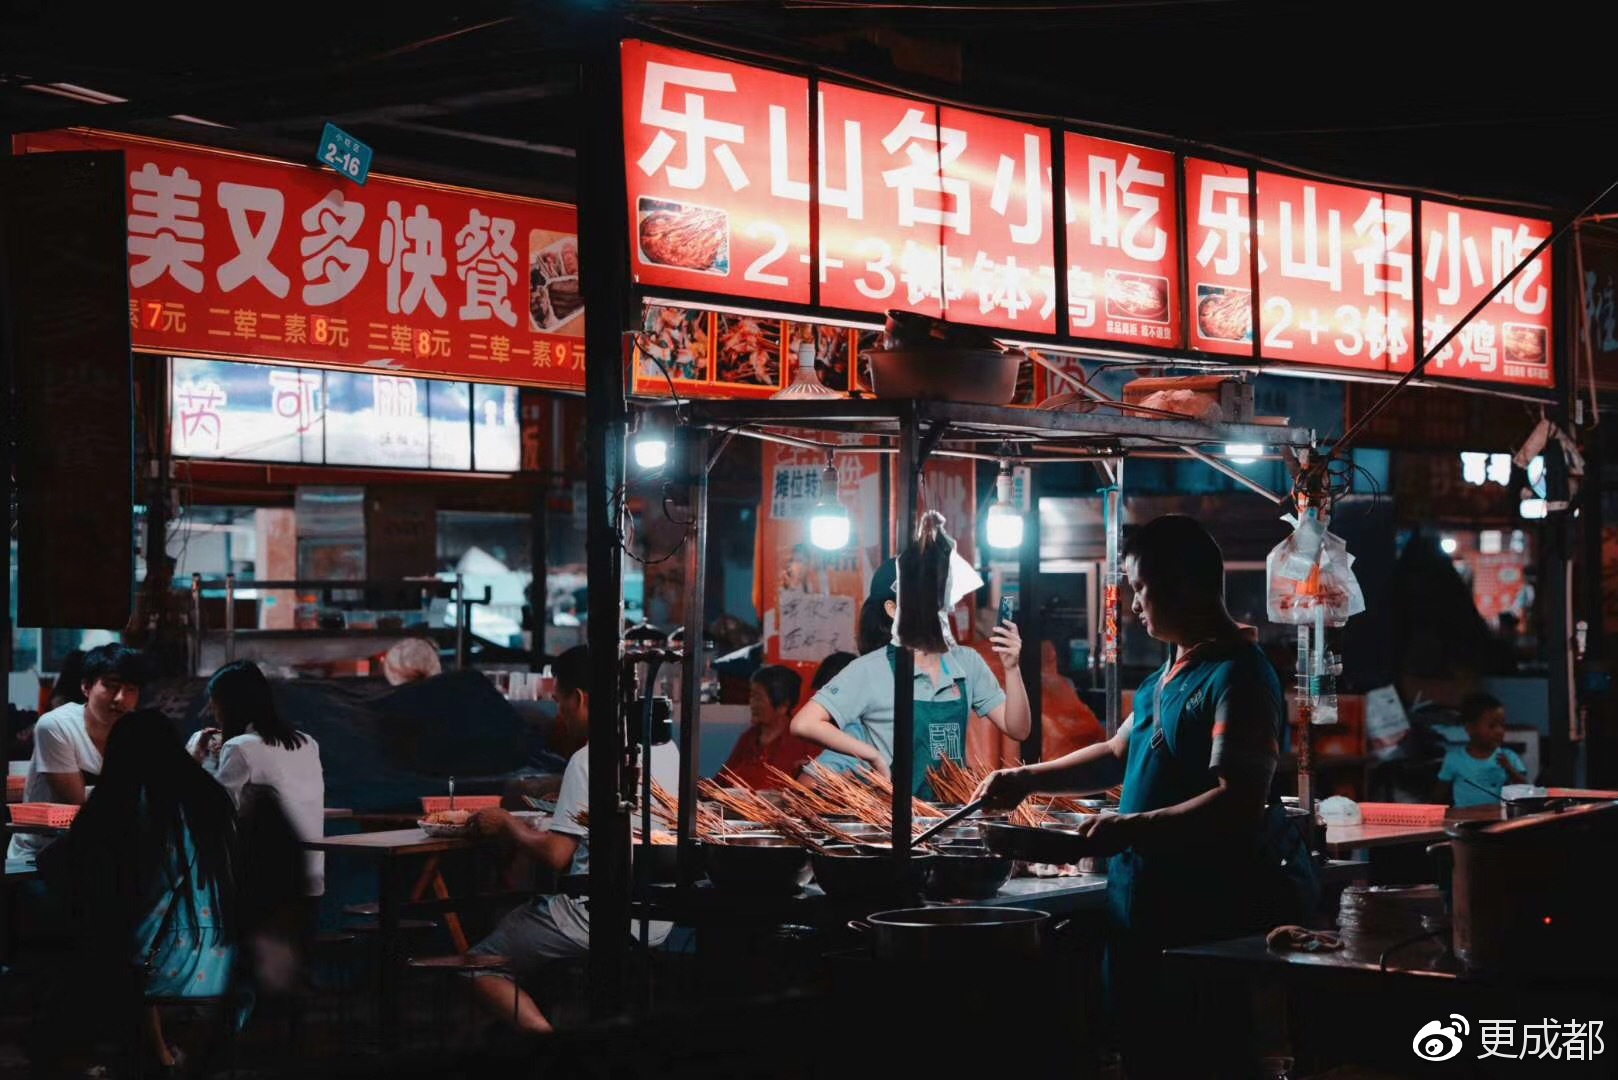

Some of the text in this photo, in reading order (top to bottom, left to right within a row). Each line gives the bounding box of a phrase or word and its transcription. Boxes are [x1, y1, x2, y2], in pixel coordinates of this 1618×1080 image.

[324, 143, 361, 176] 2-16
[637, 61, 1168, 262] 乐山名小吃
[127, 162, 518, 327] 美又多快餐
[1196, 174, 1549, 314] 乐山名小吃
